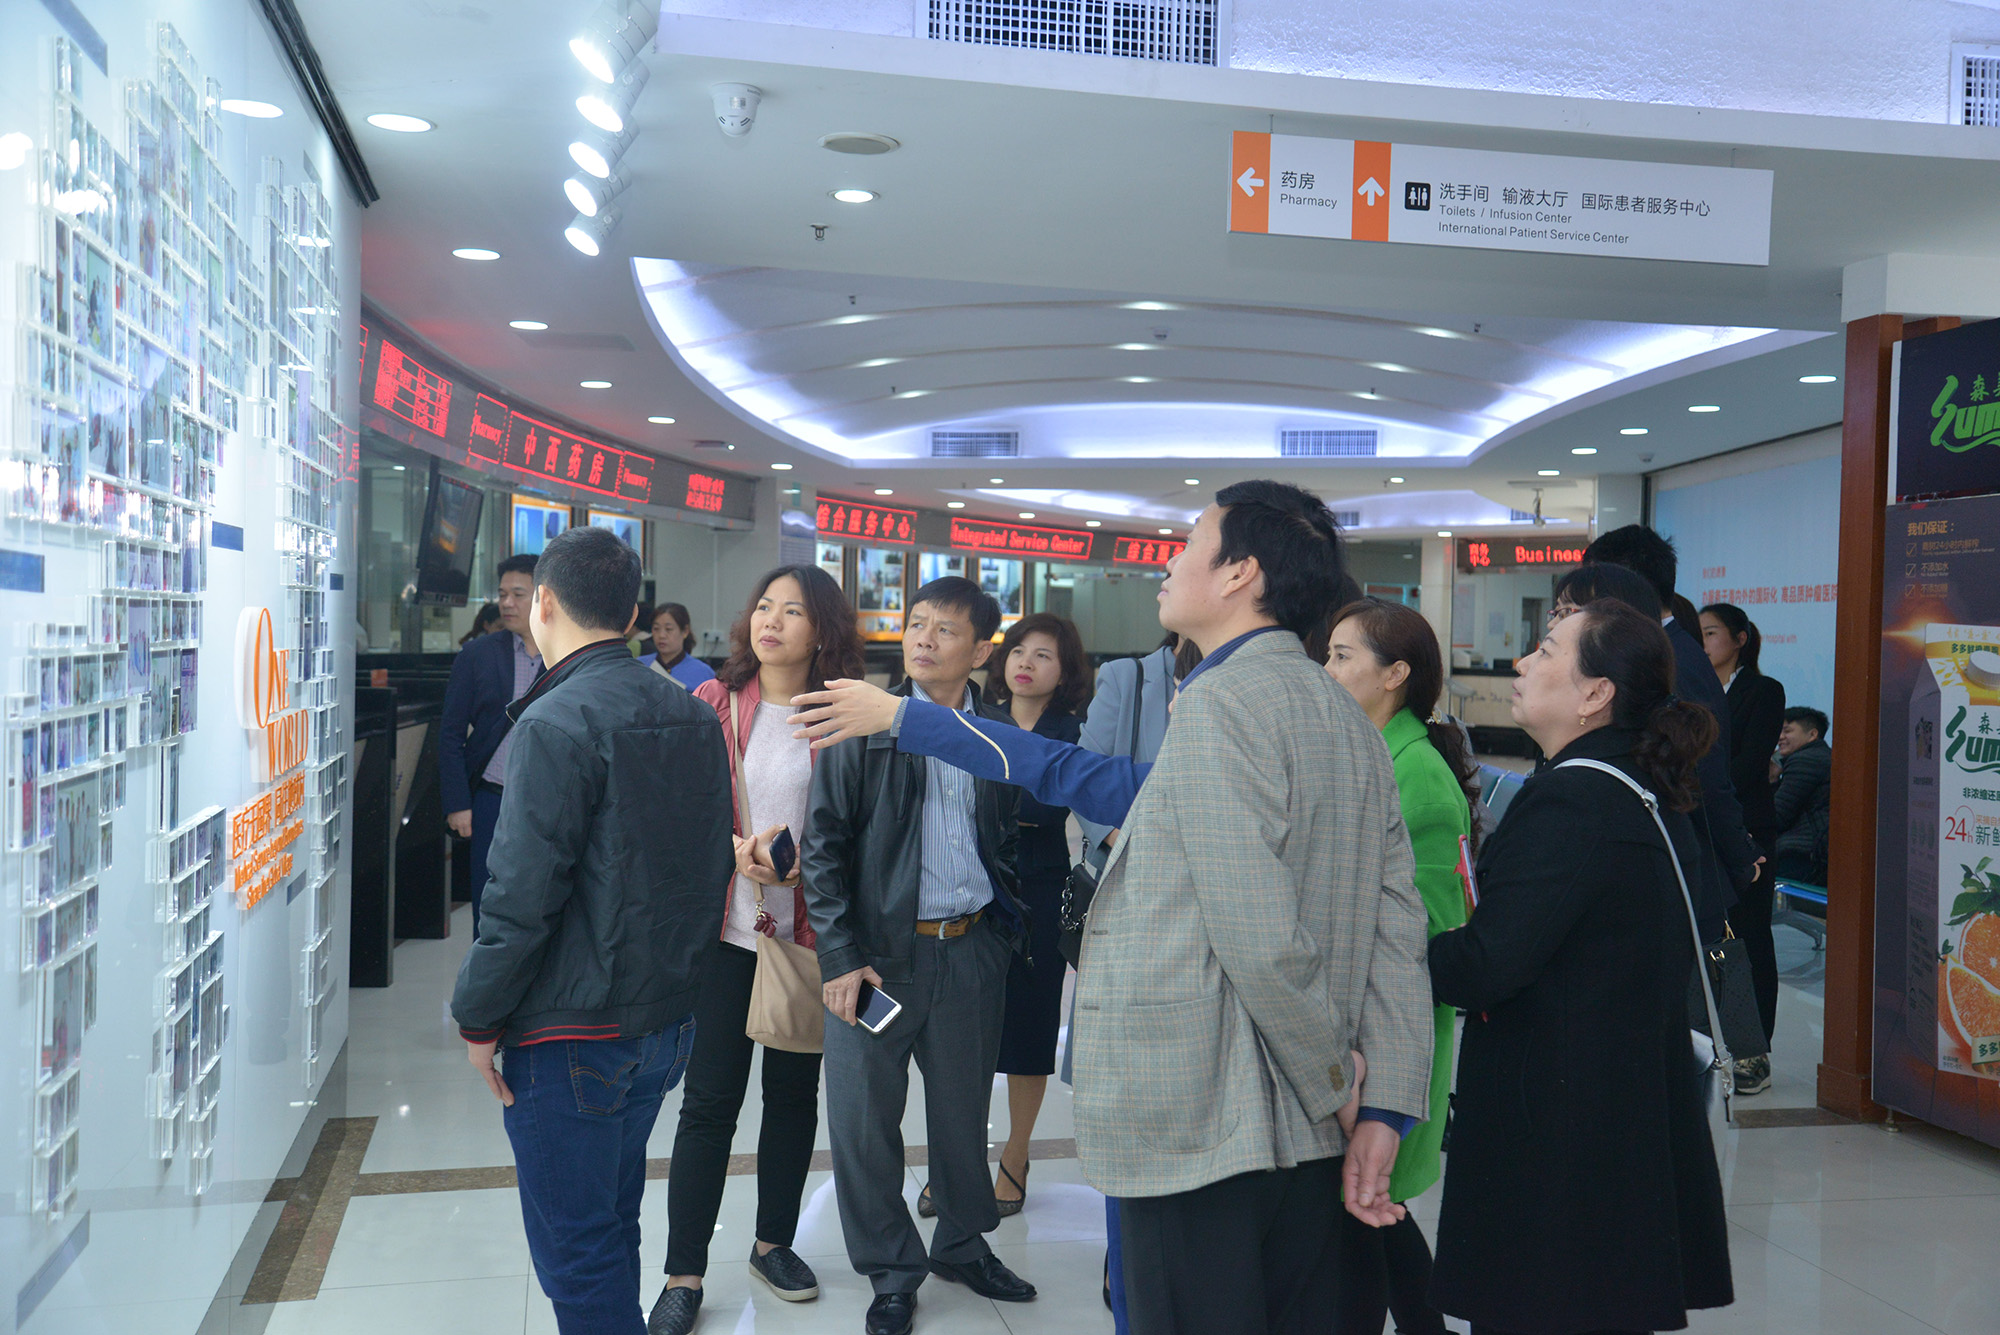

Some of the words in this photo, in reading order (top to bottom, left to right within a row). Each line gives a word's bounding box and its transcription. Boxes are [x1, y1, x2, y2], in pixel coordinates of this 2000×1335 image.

[1281, 170, 1315, 190] 药房
[1280, 194, 1338, 210] Pharmacy
[1439, 182, 1490, 204] 洗手间
[1502, 186, 1569, 208] 输液大厅
[1581, 193, 1711, 217] 国际患者服务中心
[1439, 205, 1476, 218] Toilets
[1480, 208, 1485, 219] /
[1489, 208, 1532, 221] Infusion
[1535, 211, 1573, 224] Center
[1438, 222, 1507, 237] International
[1509, 226, 1548, 240] Patient
[1550, 229, 1591, 242] Service
[1592, 231, 1629, 244] Center
[523, 427, 605, 486] 中西药房
[816, 503, 911, 539] 综合服务中心
[952, 523, 1008, 548] Integrated
[1009, 530, 1049, 550] Service
[1050, 535, 1085, 554] Center
[1469, 543, 1490, 556] 商务
[1469, 555, 1491, 567] 中心
[254, 607, 290, 729] ONE
[1978, 712, 2000, 735] 森
[267, 709, 309, 782] WORLD
[232, 793, 272, 859] 医疗无国界
